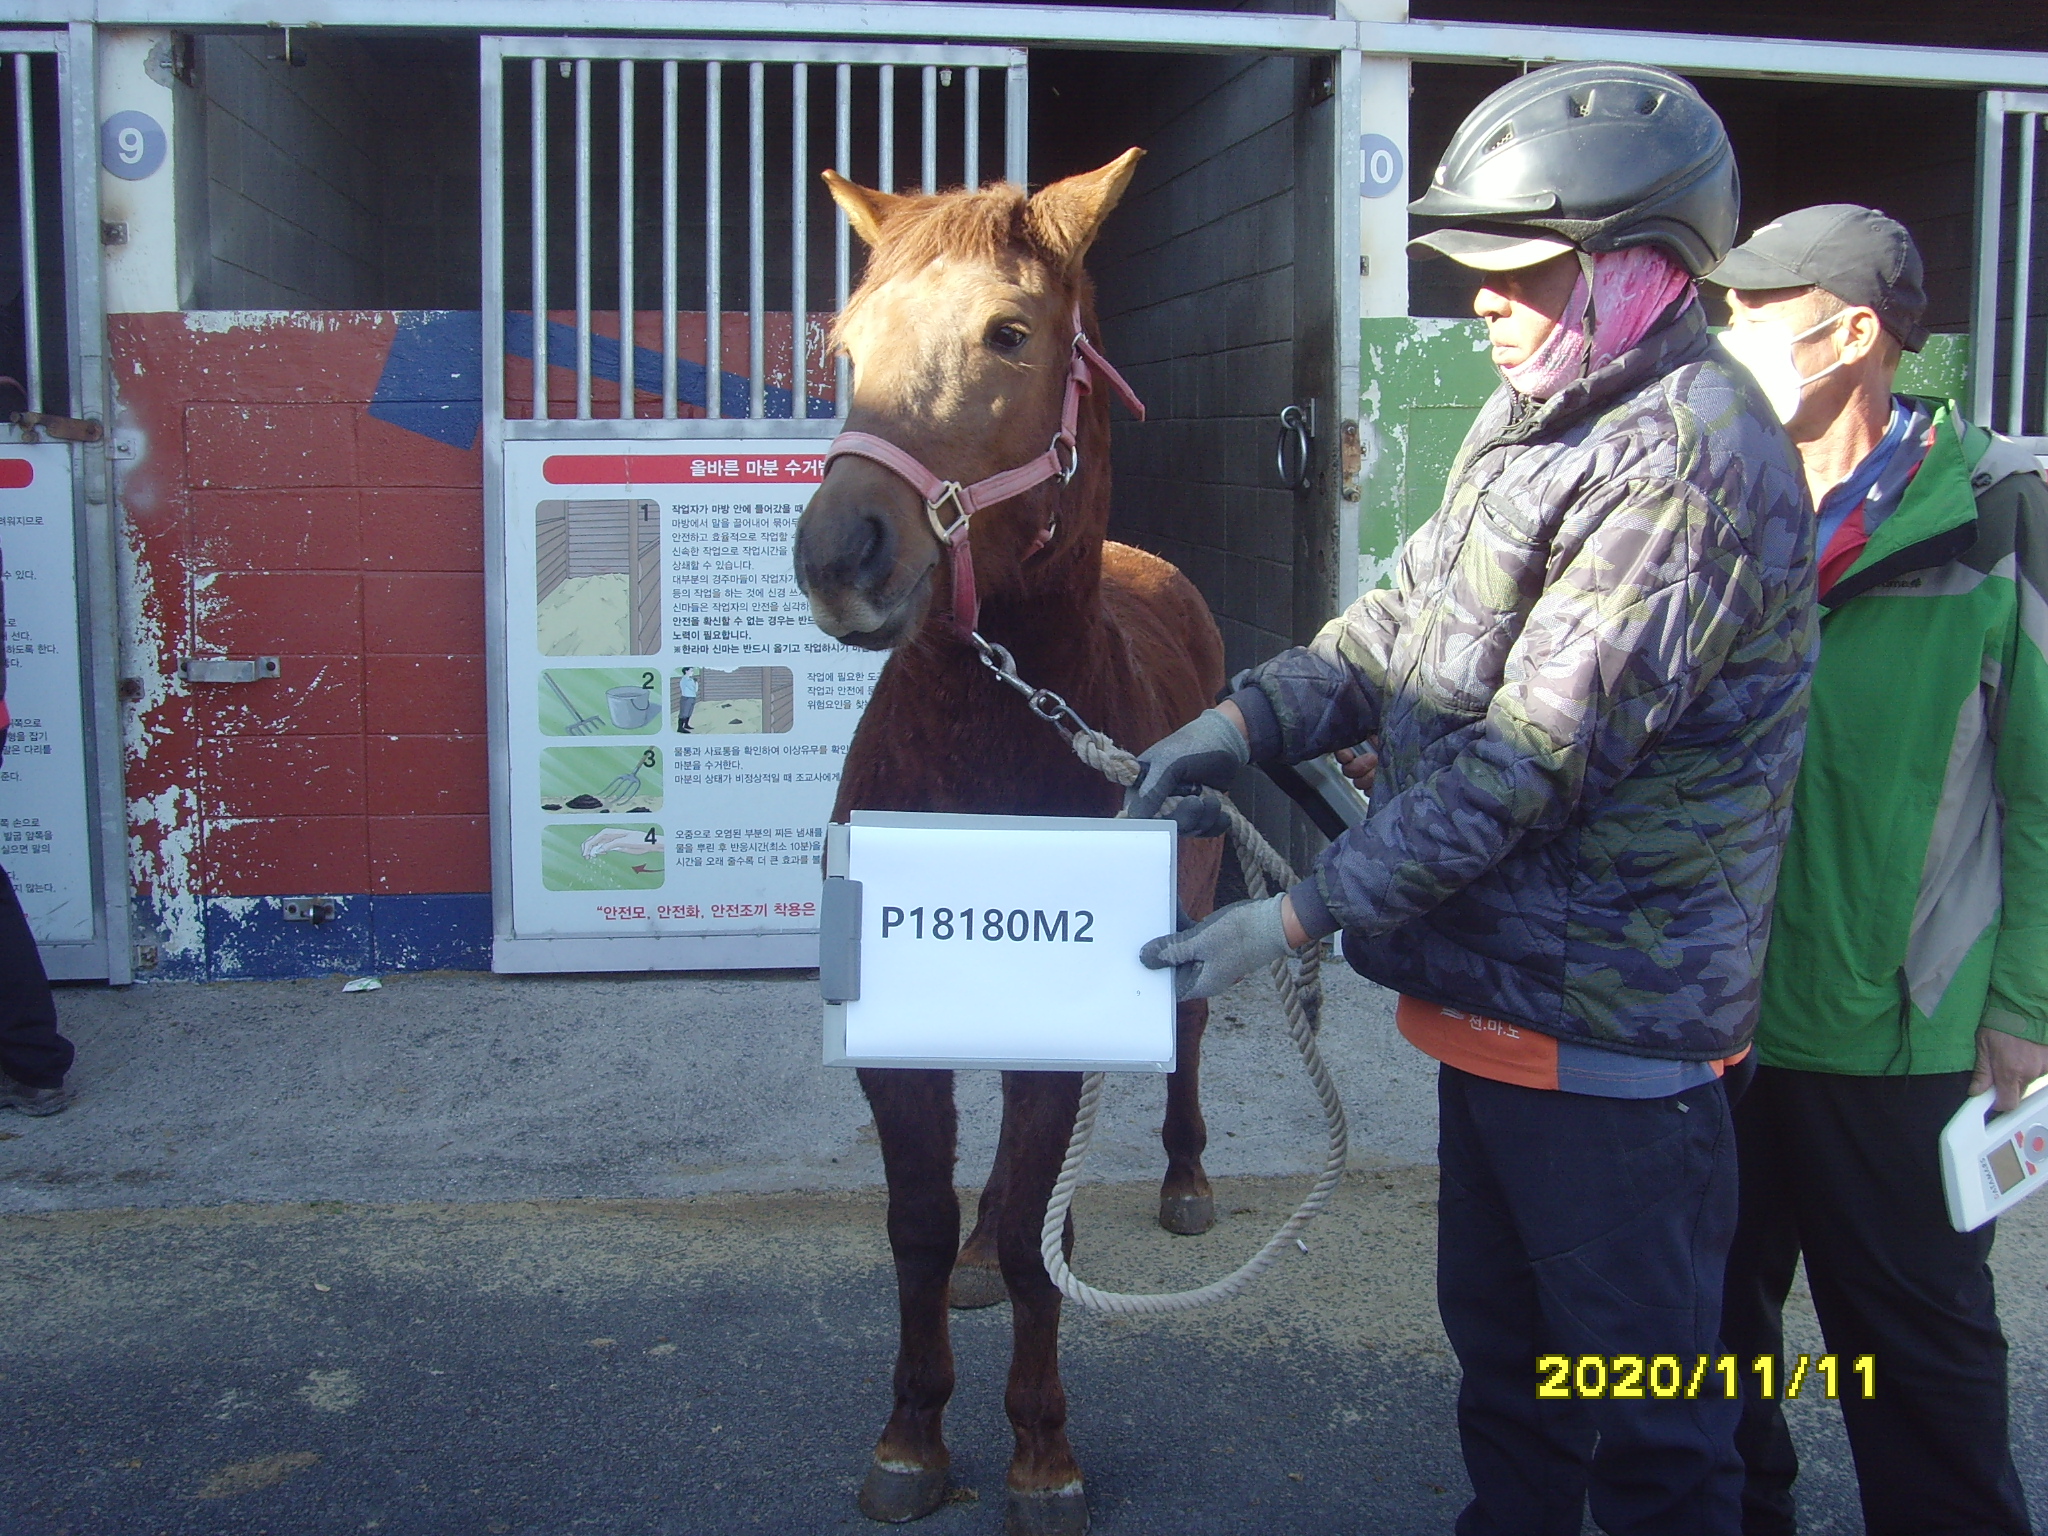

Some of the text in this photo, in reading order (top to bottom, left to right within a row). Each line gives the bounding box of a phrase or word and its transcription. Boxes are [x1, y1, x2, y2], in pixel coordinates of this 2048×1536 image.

[119, 127, 144, 165] 9
[1360, 149, 1394, 184] 10
[690, 459, 740, 477] 올바른
[746, 459, 779, 477] 마분
[640, 503, 649, 522] 1
[671, 504, 804, 514] 작업자가 마방 안에 들어갔을 때
[671, 518, 708, 528] 마방에서
[711, 518, 730, 528] 말을
[733, 518, 769, 528] 끌어내어
[671, 532, 708, 542] 안전하고
[711, 532, 757, 542] 효율적으로
[761, 532, 788, 542] 작업할
[672, 546, 788, 556] 신속한 작업으로 작업시간을
[672, 561, 754, 570] 상쇄할 수 있습니다.
[15, 570, 37, 580] 있다.
[672, 575, 709, 584] 대부분의
[712, 575, 757, 584] 경주마들이
[672, 589, 691, 599] 등의
[694, 588, 721, 598] 작업을
[724, 588, 743, 598] 하는
[746, 588, 764, 598] 것에
[768, 588, 786, 597] 신경
[672, 603, 709, 613] 신마들은
[712, 602, 748, 612] 작업자의
[752, 602, 780, 612] 안전을
[5, 618, 17, 627] 로
[672, 617, 699, 627] 안전을
[703, 617, 731, 627] 확신할
[733, 617, 743, 626] 수
[746, 617, 765, 626] 없는
[768, 616, 795, 626] 경우는
[12, 631, 33, 641] 선다.
[672, 631, 752, 641] 노력이 필요합니다.
[38, 644, 59, 654] 한다.
[712, 644, 740, 654] 신마는
[743, 644, 770, 653] 반드시
[642, 671, 655, 690] 2
[807, 672, 834, 682] 작업에
[837, 672, 864, 682] 필요한
[807, 686, 834, 696] 작업과
[837, 686, 864, 696] 안전에
[807, 700, 851, 710] 위험요인을
[29, 731, 47, 741] 잡기
[24, 744, 52, 755] 다리를
[674, 746, 701, 757] 물통과
[704, 746, 741, 757] 사료통을
[744, 745, 780, 756] 확인하여
[783, 745, 828, 755] 이상유무를
[643, 750, 656, 767] 3
[674, 760, 744, 771] 마분을 수거한다.
[674, 772, 841, 785] 마분의 상태가 비정상적일 때 조교사에게
[13, 818, 41, 828] 손으로
[644, 827, 657, 845] 4
[675, 828, 823, 840] 오줌으로 오염된 부분의 찌든 냄새를
[32, 844, 51, 854] 말의
[676, 841, 821, 853] 물을 뿌린 후 반응시간(최소 10분)을
[676, 857, 703, 867] 시간을
[706, 856, 724, 866] 오래
[757, 856, 766, 866] 더
[770, 855, 779, 865] 큰
[782, 855, 809, 865] 효과를
[26, 883, 56, 893] 않는다.
[657, 904, 705, 919] 안전화,
[711, 903, 768, 918] 안전조끼
[773, 902, 816, 917] 착용은
[881, 906, 1095, 943] P18180M2
